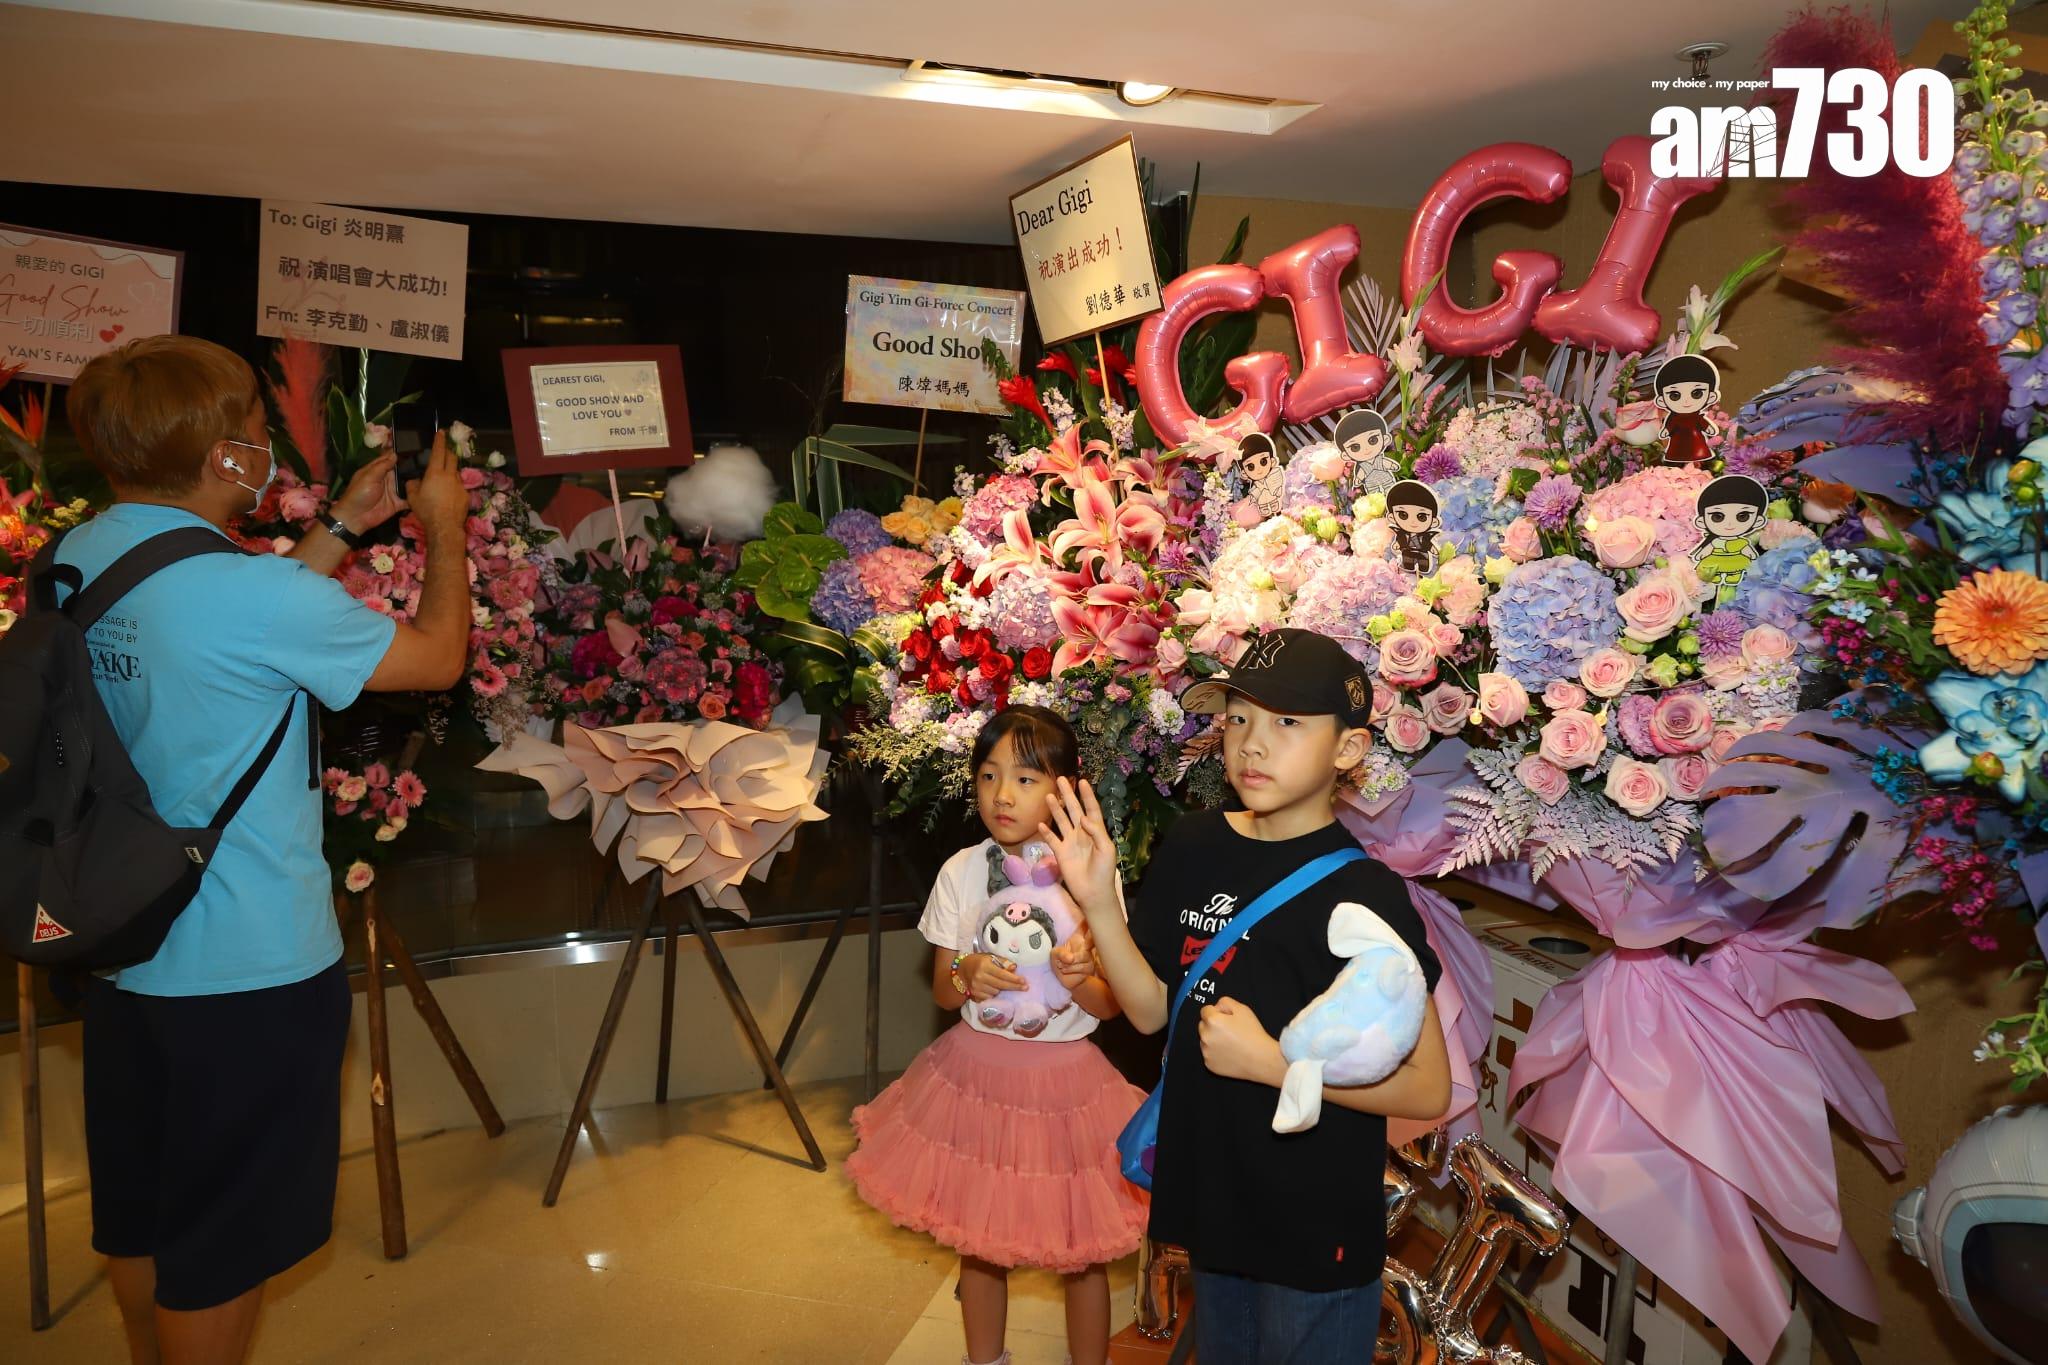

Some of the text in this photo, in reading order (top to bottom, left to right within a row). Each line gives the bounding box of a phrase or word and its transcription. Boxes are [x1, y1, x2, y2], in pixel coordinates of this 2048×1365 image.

[1017, 179, 1094, 236] Dear Gigi
[268, 208, 297, 226] To:
[302, 214, 337, 236] Gigi
[15, 254, 104, 280] 親愛的 GIGI
[61, 285, 129, 322] Show
[859, 290, 885, 307] Gigi
[887, 293, 911, 307] Yim
[967, 301, 1014, 316] Concert
[1085, 283, 1126, 316] 劉德華
[265, 305, 298, 323] Fm:
[8, 345, 51, 361] YAN'S
[872, 331, 1001, 361] Good Sho
[542, 374, 606, 386] DEAREST GIGI,
[555, 394, 644, 408] GOOD SHOW AND
[572, 409, 622, 421] LOVE YOU
[609, 426, 636, 437] FROM
[130, 620, 137, 630] IS
[108, 630, 123, 641] YOU
[127, 634, 137, 643] BY
[1203, 893, 1238, 915] The
[1180, 909, 1251, 941] ORIGINL
